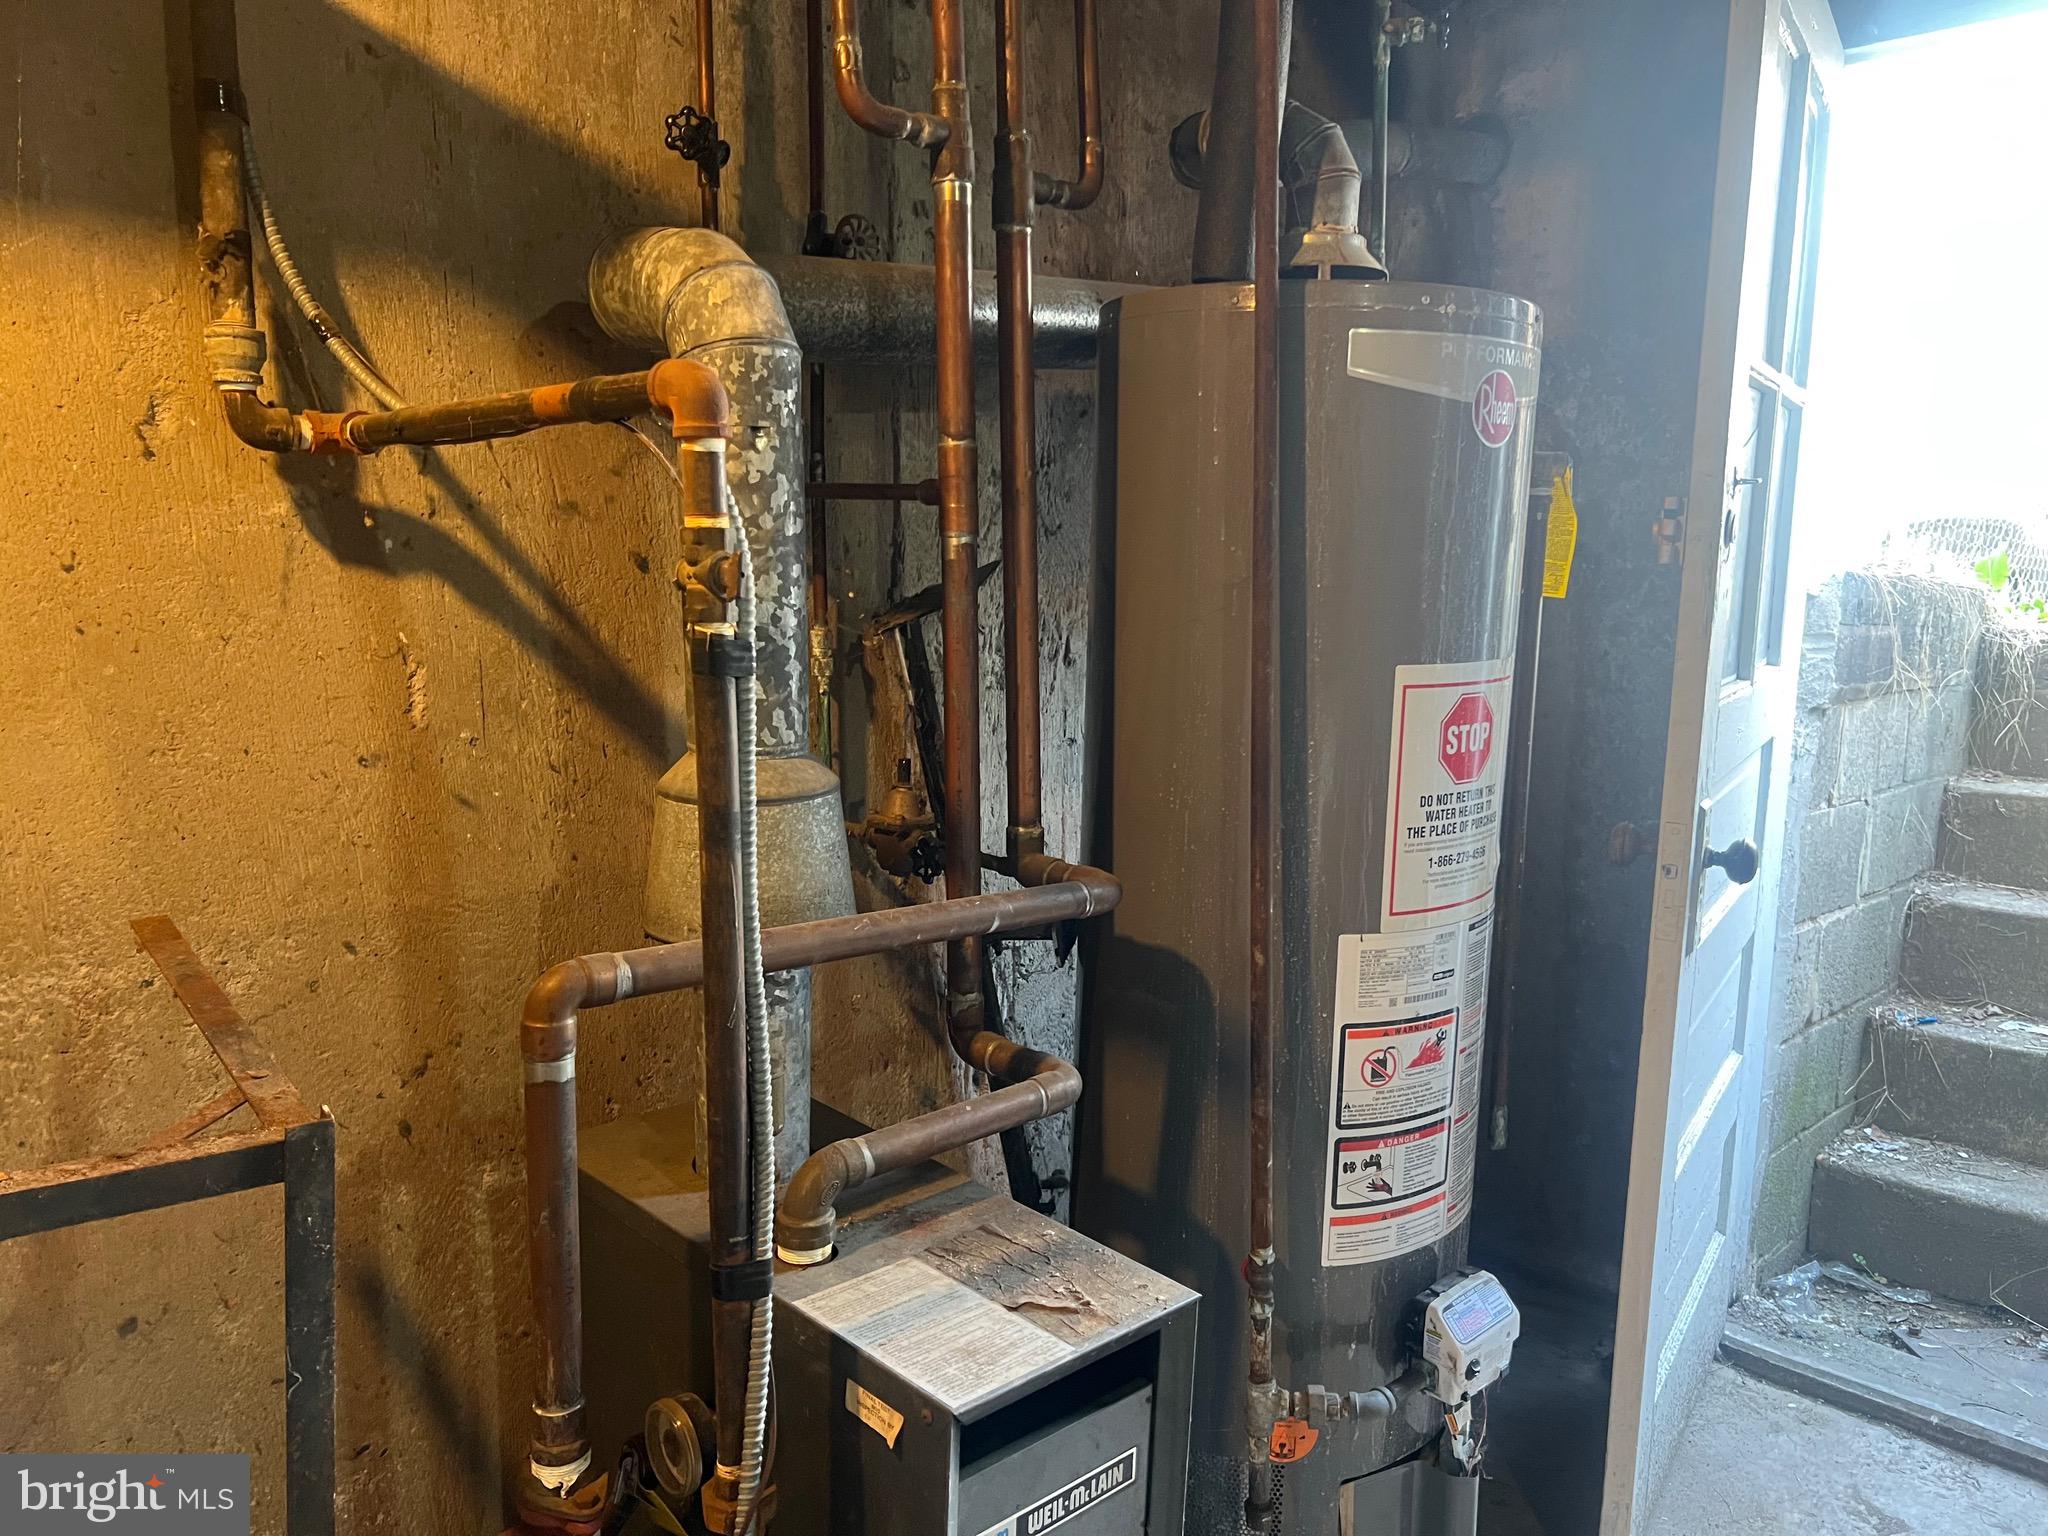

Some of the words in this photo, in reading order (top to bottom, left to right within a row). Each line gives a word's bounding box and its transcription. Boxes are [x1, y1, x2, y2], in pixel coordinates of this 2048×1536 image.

[1478, 373, 1515, 434] Rheem
[1445, 722, 1490, 755] STOP
[1420, 795, 1433, 808] DO
[1436, 792, 1454, 806] NOT
[1456, 787, 1484, 804] RETURN
[1425, 807, 1457, 822] WATER
[1458, 801, 1484, 818] HEATER
[1407, 826, 1426, 839] THE
[1429, 822, 1457, 837] PLACE
[1459, 820, 1469, 833] OF
[1395, 1022, 1433, 1035] WARNING
[1387, 1133, 1420, 1147] DANGER
